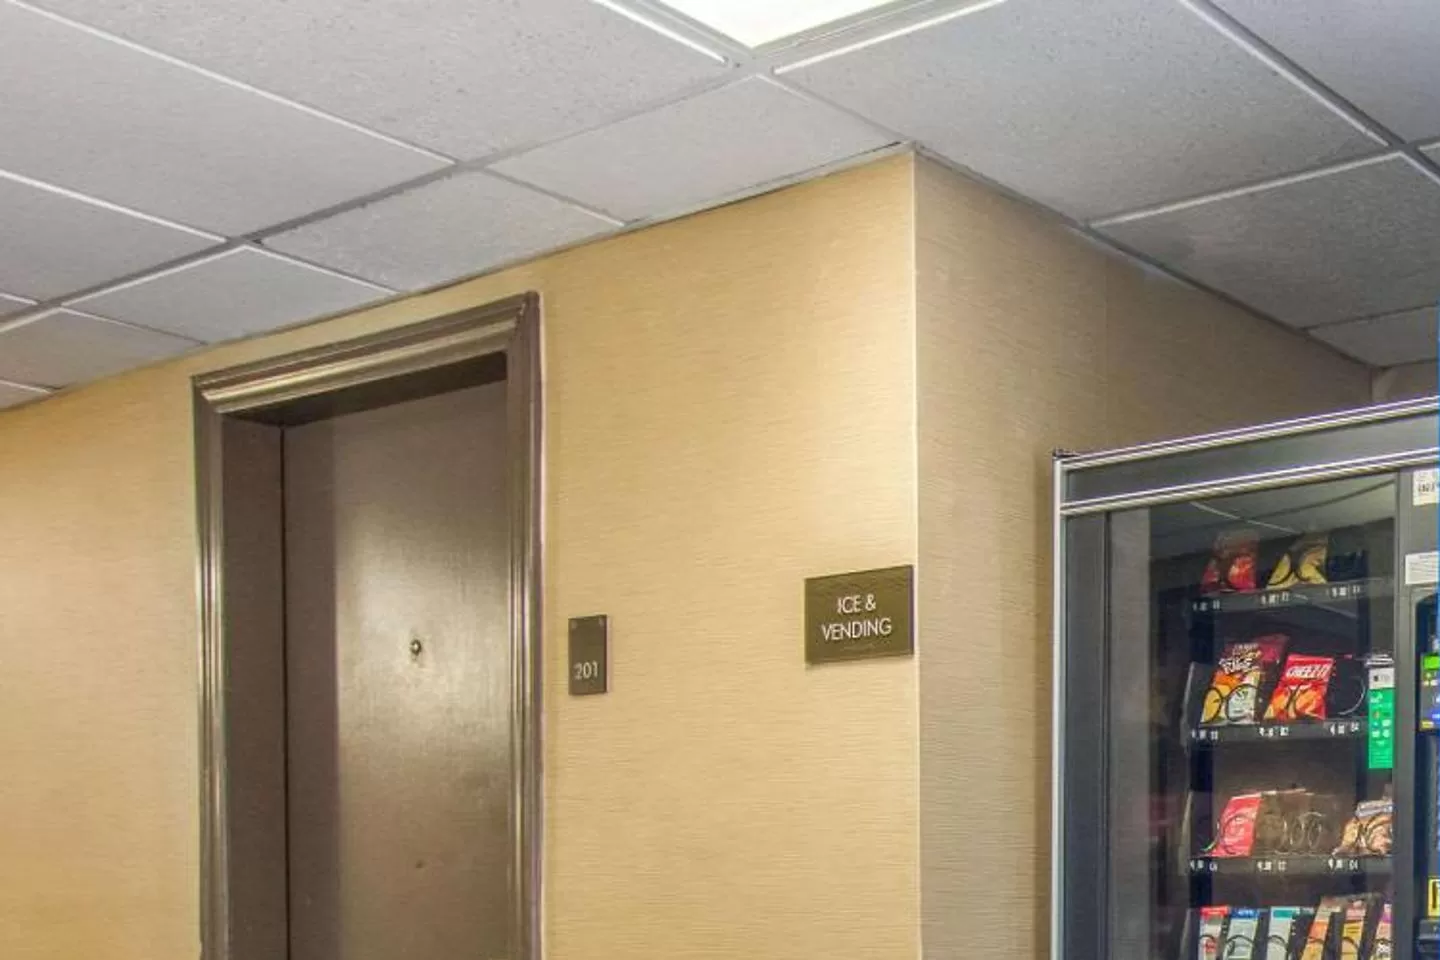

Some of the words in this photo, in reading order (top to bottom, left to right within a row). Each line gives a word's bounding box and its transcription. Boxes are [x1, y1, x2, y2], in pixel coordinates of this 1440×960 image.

[837, 595, 862, 615] ICE
[864, 593, 877, 612] &
[821, 617, 893, 643] VENDING
[574, 660, 599, 682] 201
